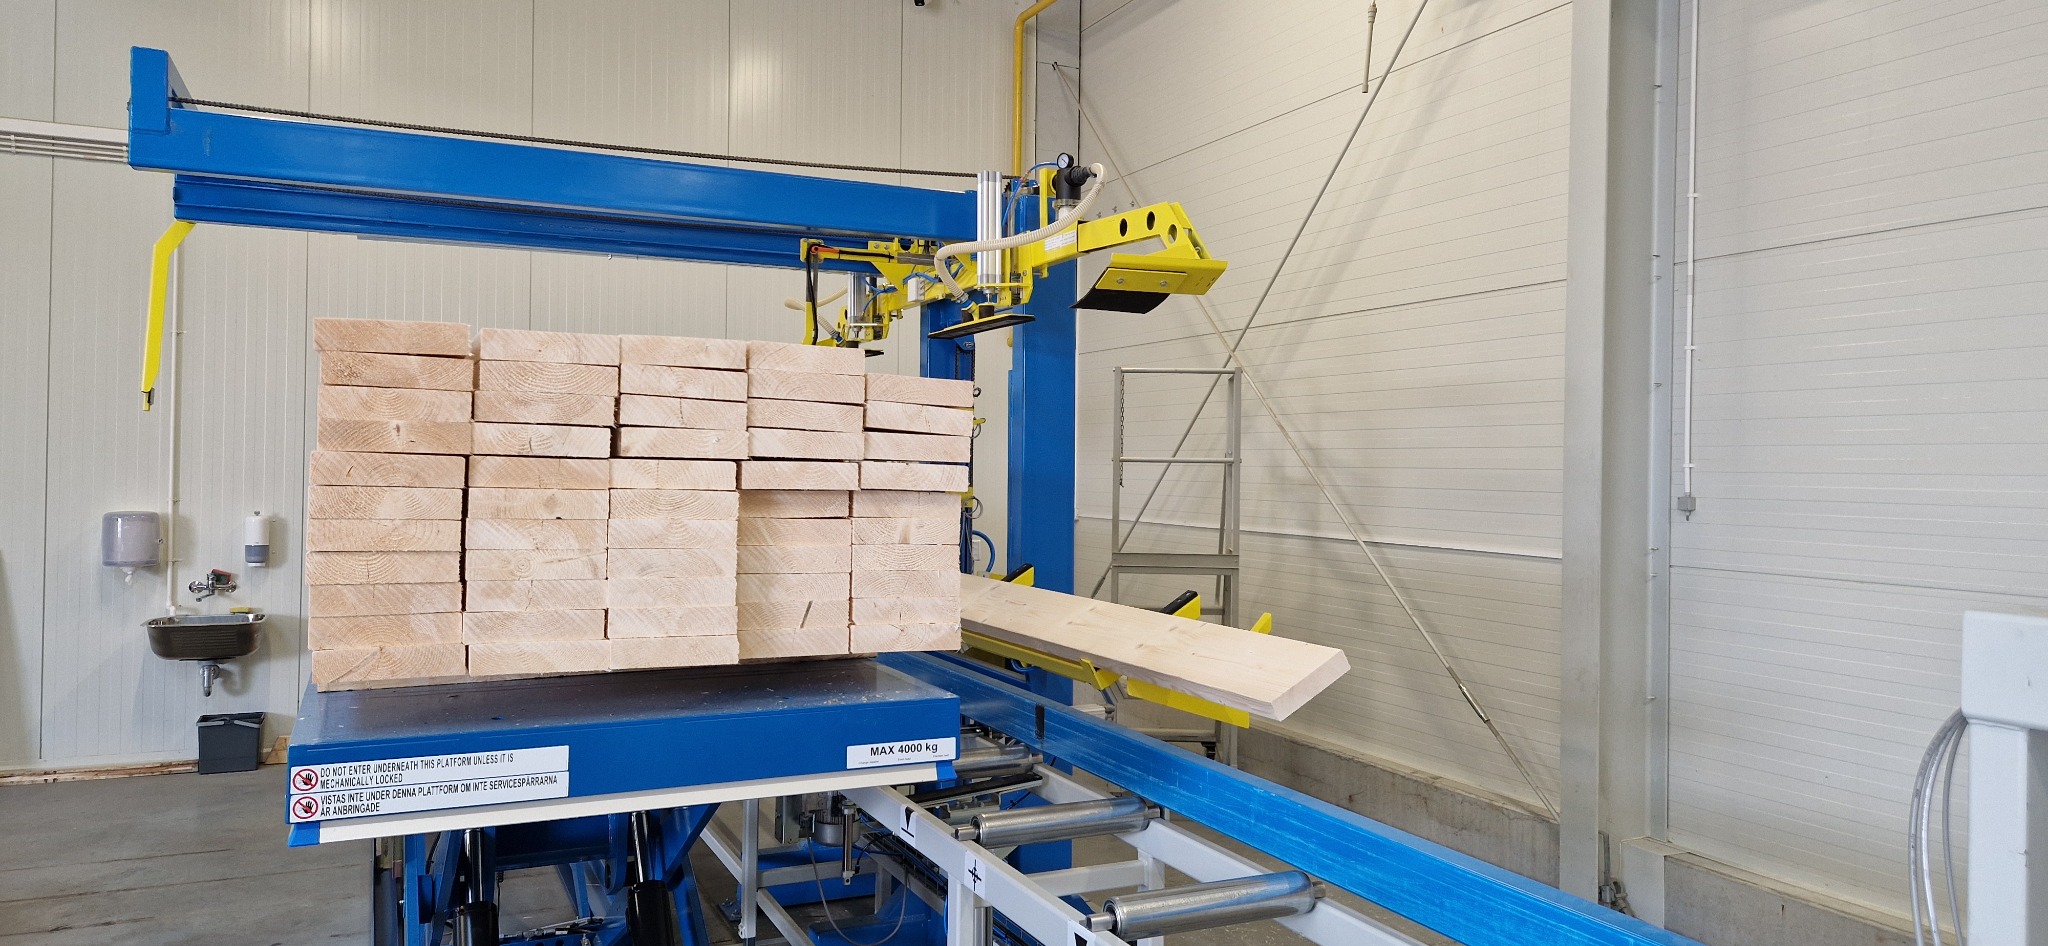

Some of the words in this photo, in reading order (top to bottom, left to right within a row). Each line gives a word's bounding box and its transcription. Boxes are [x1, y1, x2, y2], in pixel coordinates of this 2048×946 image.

[870, 745, 895, 756] MAX
[898, 743, 922, 754] 4000
[925, 742, 938, 753] kg
[321, 767, 330, 778] DO
[333, 766, 347, 777] NOT
[349, 764, 371, 776] ENTER
[374, 761, 418, 773] UNDERNEATH
[421, 759, 435, 769] THIS
[436, 757, 472, 768] PLATFORM
[473, 754, 498, 766] UNLESS
[500, 753, 506, 763] IT
[508, 753, 514, 763] IS
[320, 776, 374, 789] MECHANICALLY
[376, 773, 403, 785] LOCKED
[321, 795, 345, 805] VISTAS
[347, 793, 363, 803] INTE
[366, 790, 391, 801] UNDER
[392, 787, 417, 799] DENNA
[418, 783, 459, 796] PLATTFORM
[460, 782, 471, 793] OM
[472, 780, 488, 791] INTE
[489, 776, 557, 790] SERVICESPÄRRARNA
[332, 802, 380, 815] ANBRINGADE
